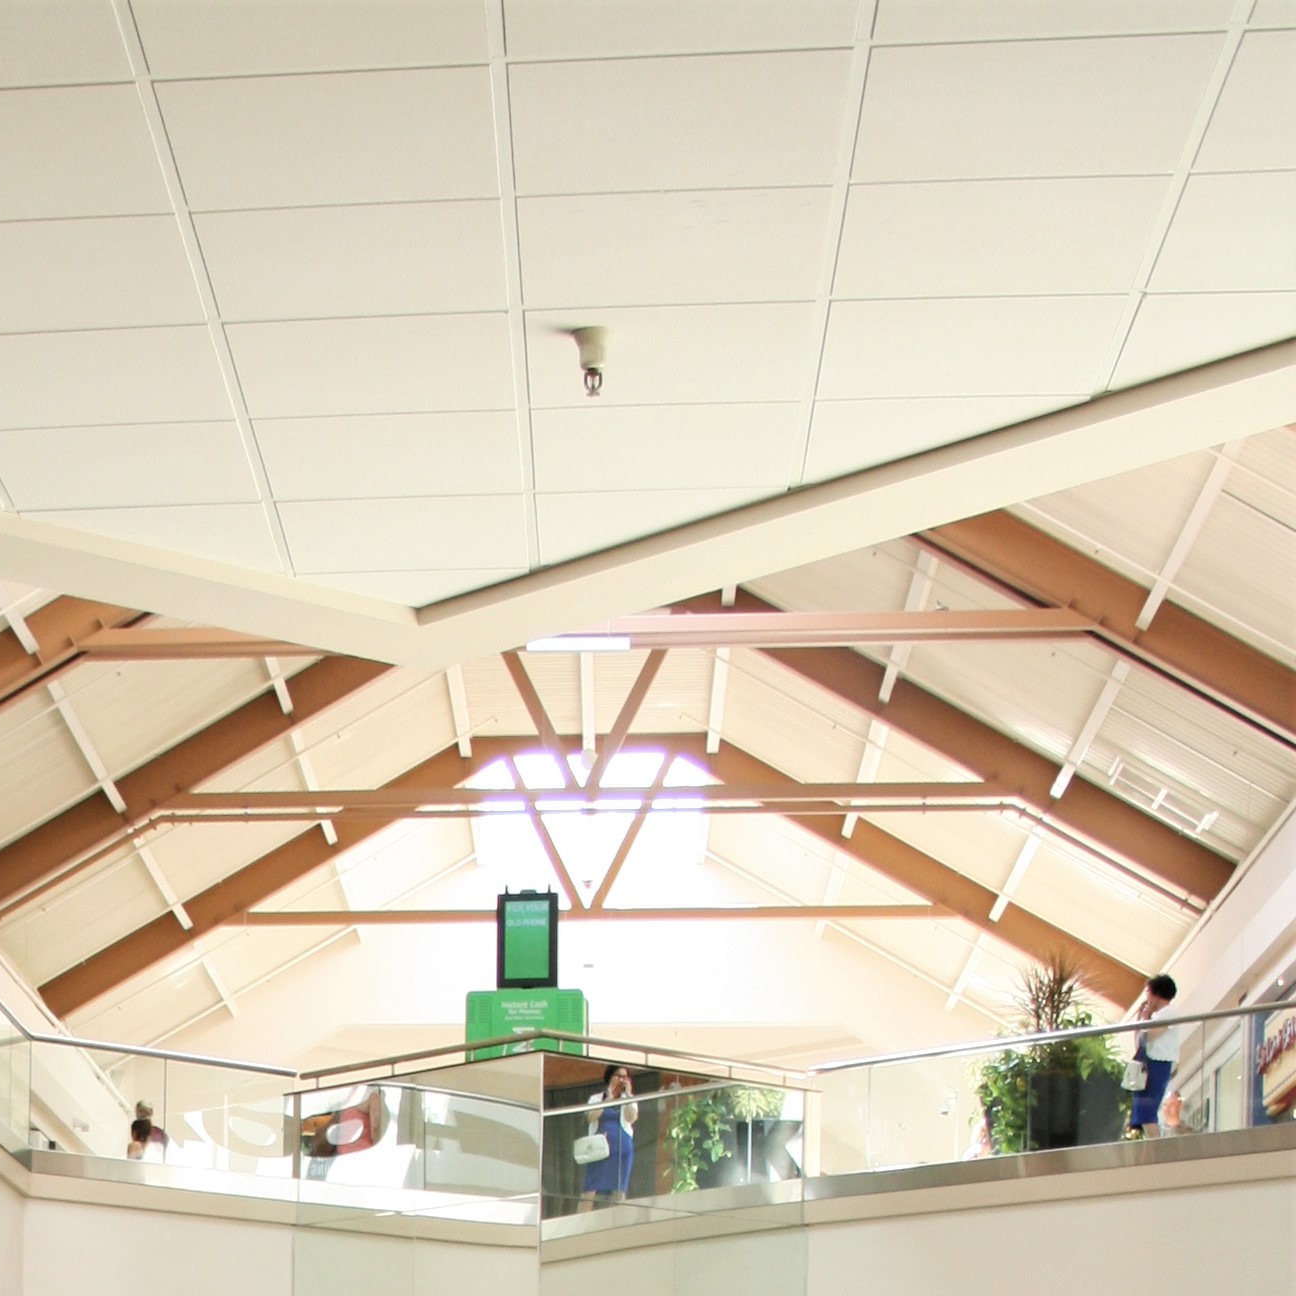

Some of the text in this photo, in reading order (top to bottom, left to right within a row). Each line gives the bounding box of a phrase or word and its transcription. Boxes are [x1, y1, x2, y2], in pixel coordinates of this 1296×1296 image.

[507, 918, 547, 927] OLD PHONE
[530, 1000, 548, 1008] Cash
